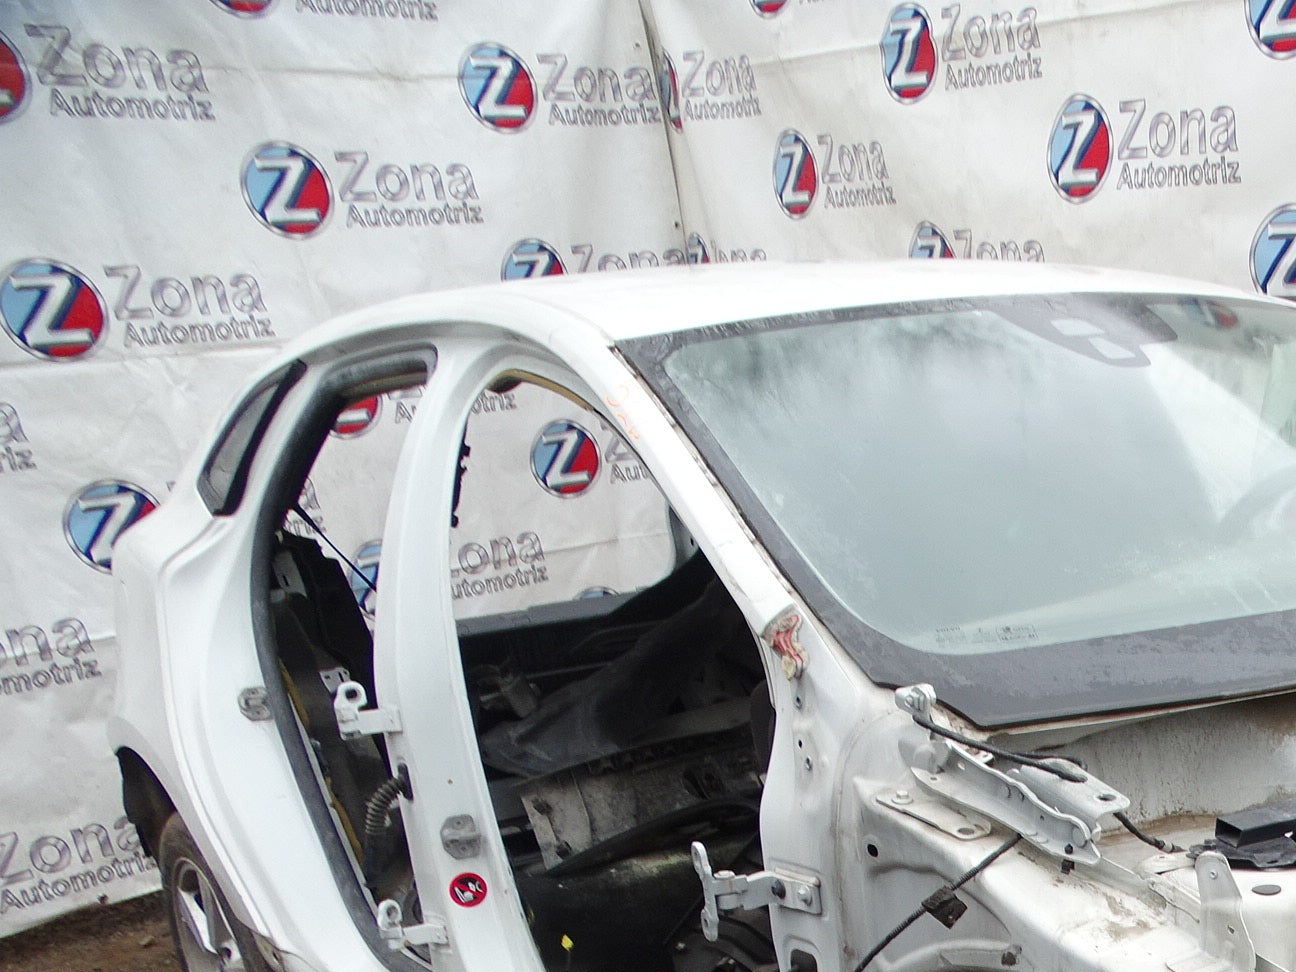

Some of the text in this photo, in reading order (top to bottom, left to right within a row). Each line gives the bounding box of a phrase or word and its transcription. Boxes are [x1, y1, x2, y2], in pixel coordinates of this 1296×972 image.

[941, 3, 1041, 62] Zona
[23, 24, 210, 93] Zona
[536, 54, 658, 102] Zona
[682, 50, 757, 98] Zona
[945, 52, 1043, 91] Automotriz
[50, 88, 216, 121] Automotriz
[548, 102, 661, 126] Automotriz
[1117, 98, 1239, 161] Zona
[334, 150, 480, 203] Zona
[817, 134, 889, 184] Zona
[1116, 156, 1242, 190] Automotriz
[347, 201, 485, 228] Automotriz
[824, 181, 897, 209] Automotriz
[103, 264, 268, 320] Zona
[123, 315, 277, 348] Automotriz
[450, 532, 546, 579] ona
[450, 564, 549, 601] utomotriz
[0, 656, 102, 695] motriz
